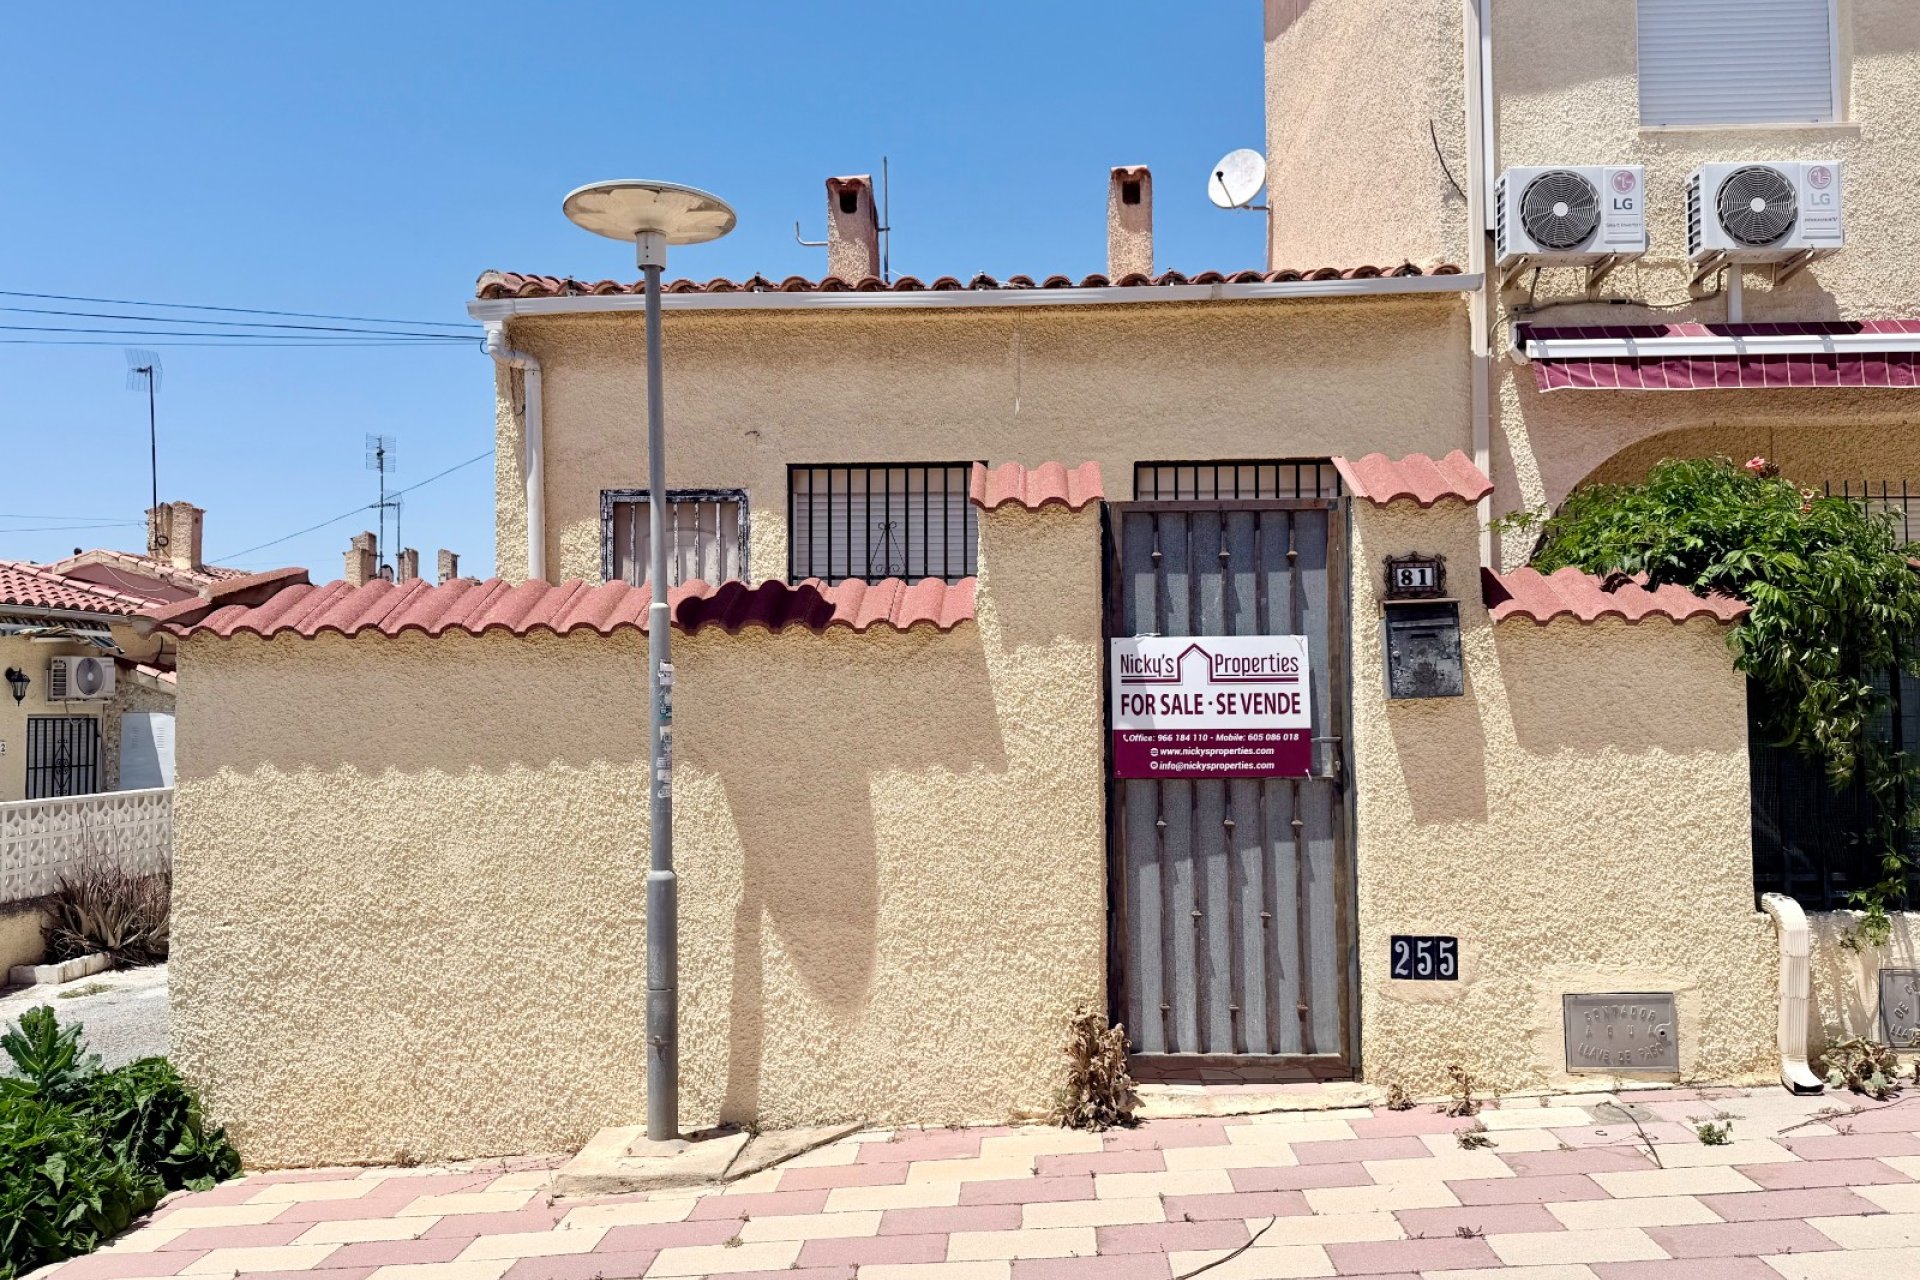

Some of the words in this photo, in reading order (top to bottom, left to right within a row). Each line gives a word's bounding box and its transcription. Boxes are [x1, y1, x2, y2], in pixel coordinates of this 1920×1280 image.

[1613, 197, 1633, 210] LG
[1810, 193, 1831, 205] LG
[1401, 569, 1427, 586] 81
[1121, 654, 1175, 677] Nicky's
[1215, 653, 1299, 676] Properties
[1121, 694, 1156, 716] FOR
[1160, 694, 1204, 715] SALE
[1216, 693, 1237, 715] SE
[1240, 692, 1301, 715] VENDE
[1128, 733, 1155, 742] Office:
[1157, 733, 1173, 742] 966
[1175, 733, 1191, 742] 184
[1193, 733, 1208, 742] 110
[1215, 733, 1246, 742] Mobile:
[1247, 733, 1264, 741] 605
[1265, 733, 1281, 741] 086
[1283, 733, 1299, 741] 018
[1160, 746, 1275, 757] www.nickysproperties.com
[1159, 761, 1275, 772] info@nickysproperties.com
[1394, 940, 1454, 976] 255
[1583, 1004, 1656, 1022] CONTADOR
[1618, 1050, 1632, 1063] DE
